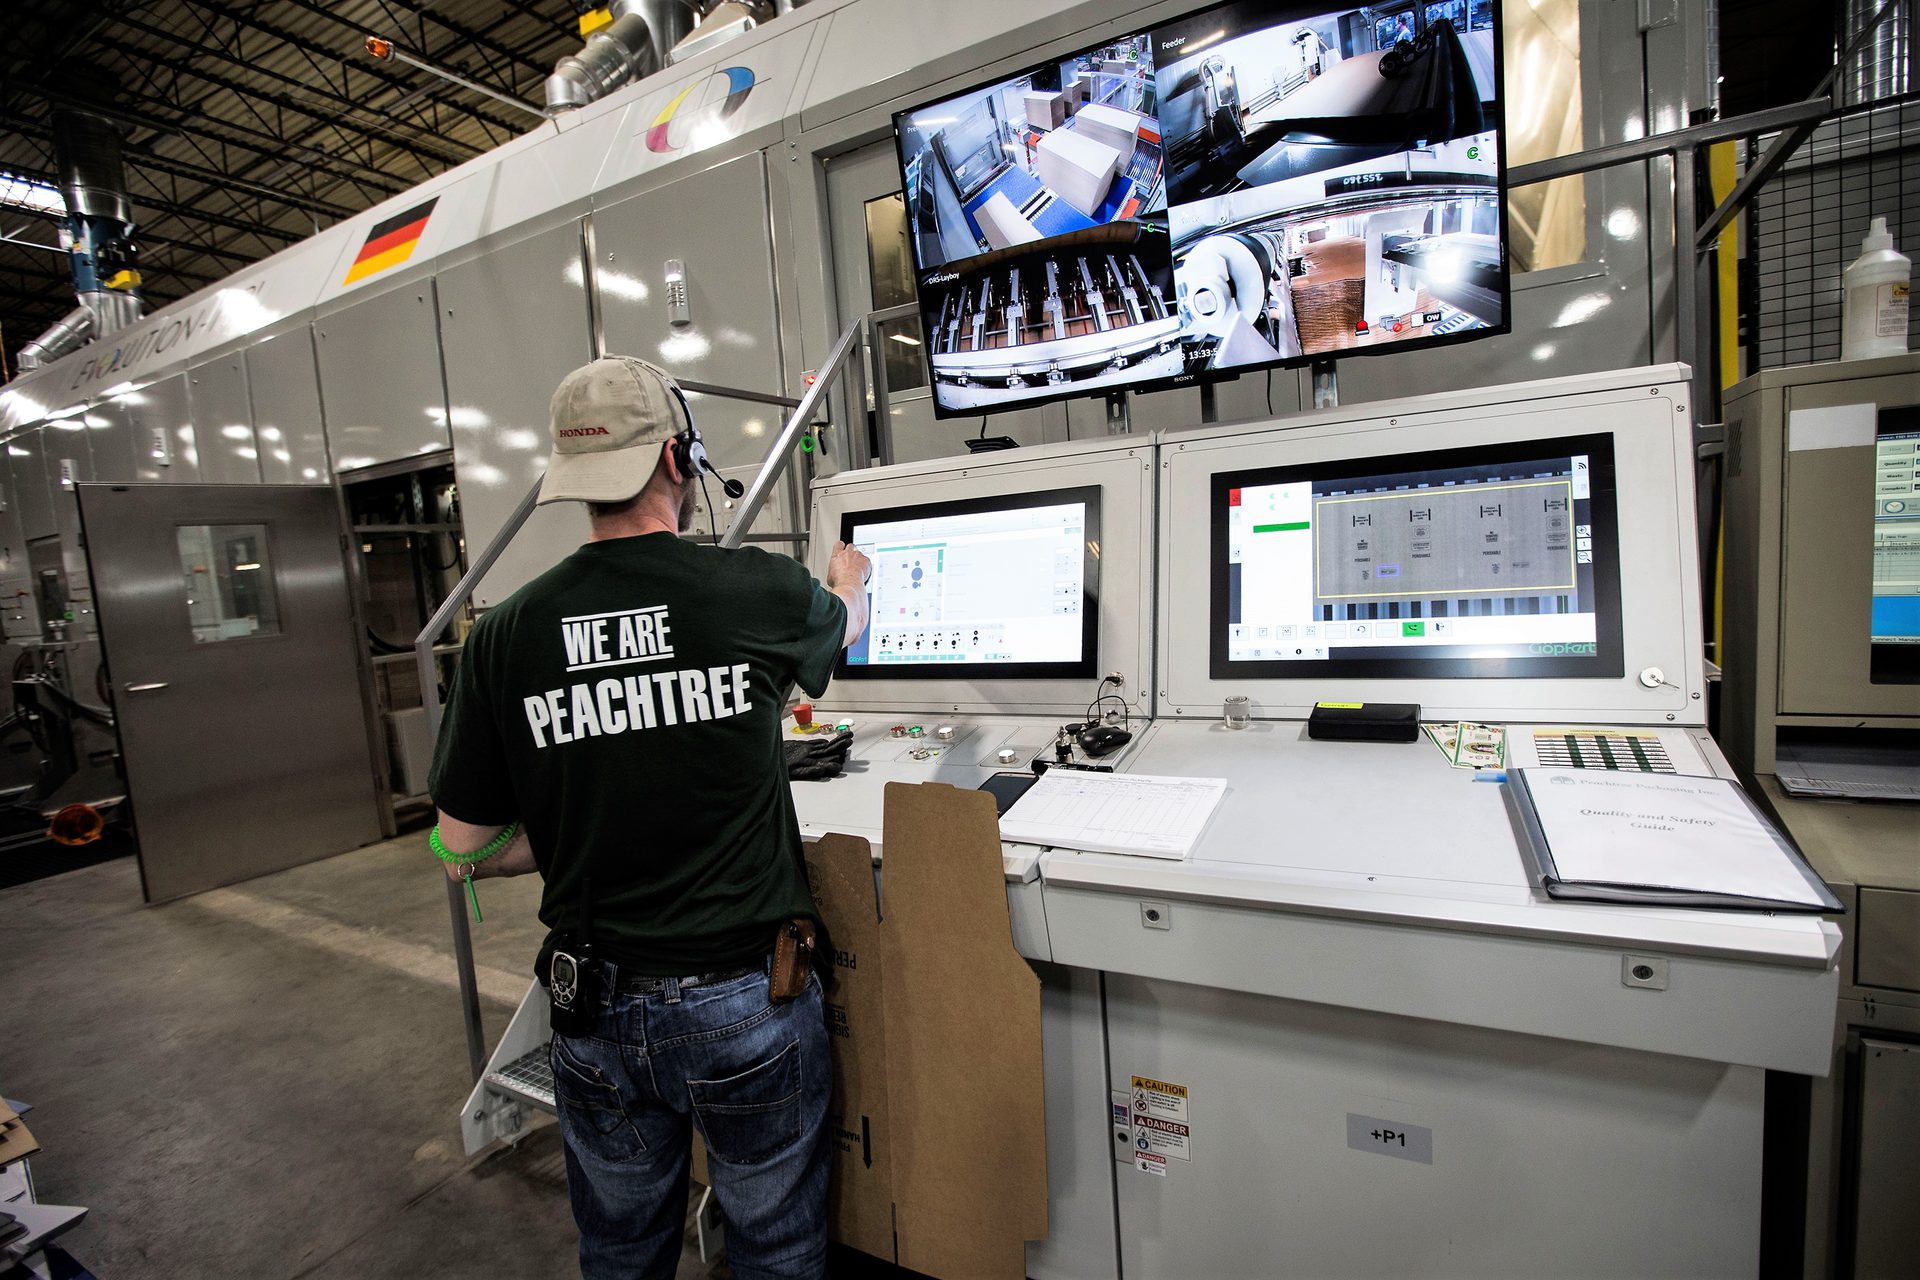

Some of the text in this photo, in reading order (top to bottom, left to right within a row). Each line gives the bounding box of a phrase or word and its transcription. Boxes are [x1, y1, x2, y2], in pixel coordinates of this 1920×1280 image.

[1162, 37, 1185, 49] Feeder
[1189, 347, 1218, 360] 13:33:5
[560, 427, 610, 438] HONDA
[562, 611, 673, 665] WE ARE
[523, 663, 752, 749] PEACHTREE
[1579, 779, 1632, 788] Peachtree
[1636, 783, 1695, 794] Packaging
[1580, 808, 1717, 827] Quality and Safety
[1630, 821, 1675, 832] Guide
[1145, 1080, 1185, 1096] CAUTION
[1147, 1119, 1187, 1135] DANGER
[1371, 1129, 1405, 1147] +P1
[1142, 1153, 1165, 1163] DANGER
